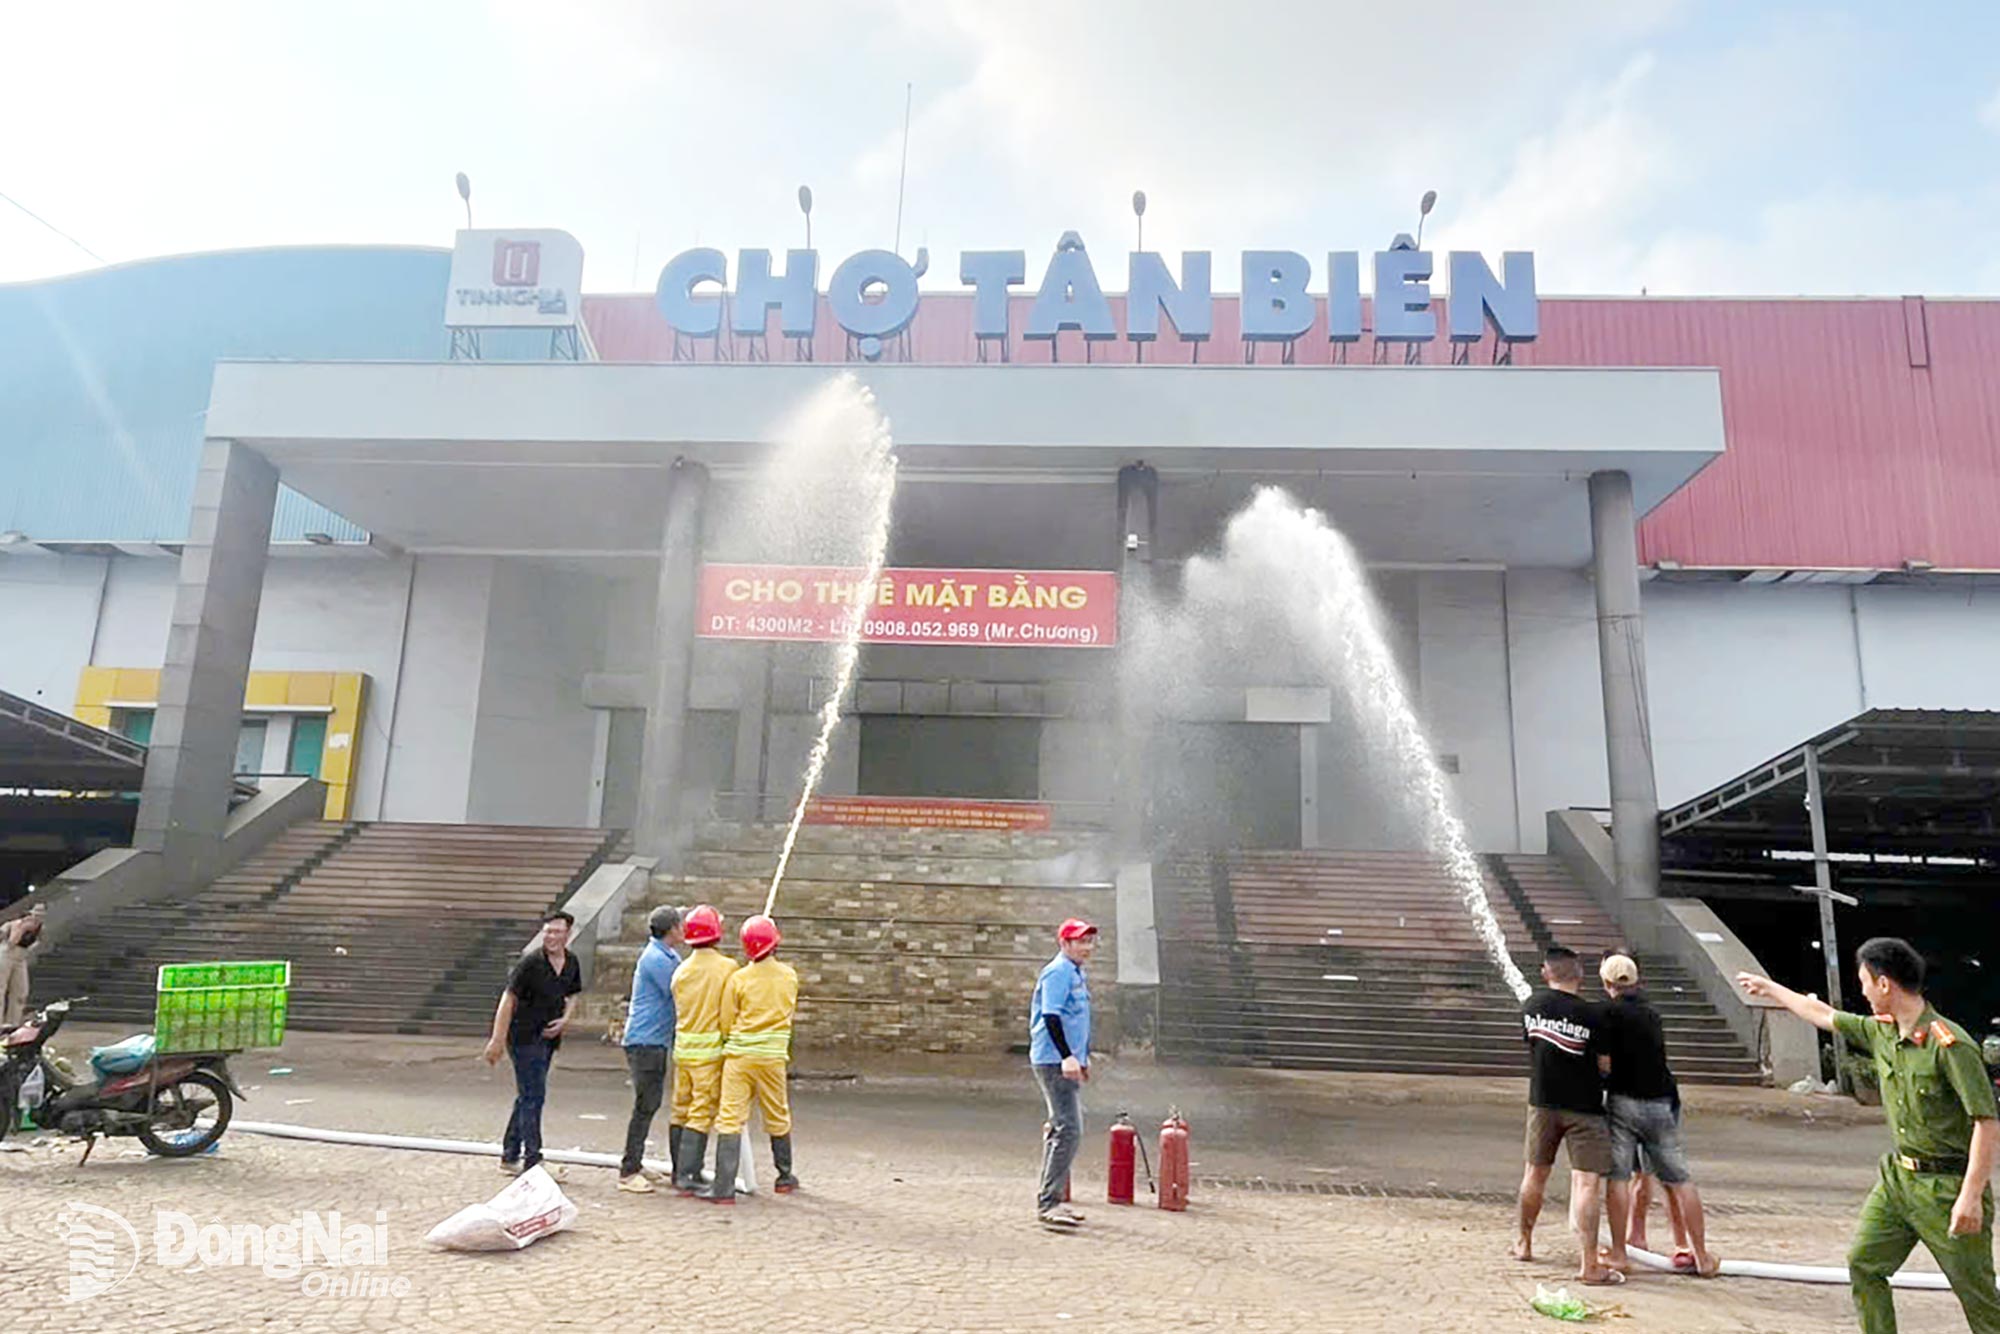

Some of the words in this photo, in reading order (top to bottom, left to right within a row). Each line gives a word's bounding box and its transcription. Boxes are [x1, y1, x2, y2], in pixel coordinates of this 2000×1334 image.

[656, 247, 928, 360] CHỢ
[960, 230, 1211, 342] TÂN
[1241, 233, 1538, 342] BIÊN
[724, 579, 804, 604] CHO
[905, 578, 978, 613] MẶT
[987, 574, 1089, 610] BẰNG
[746, 616, 814, 634] 4300M2
[864, 620, 980, 638] 0908.052.969
[985, 622, 1099, 643] (Mr.Chương)
